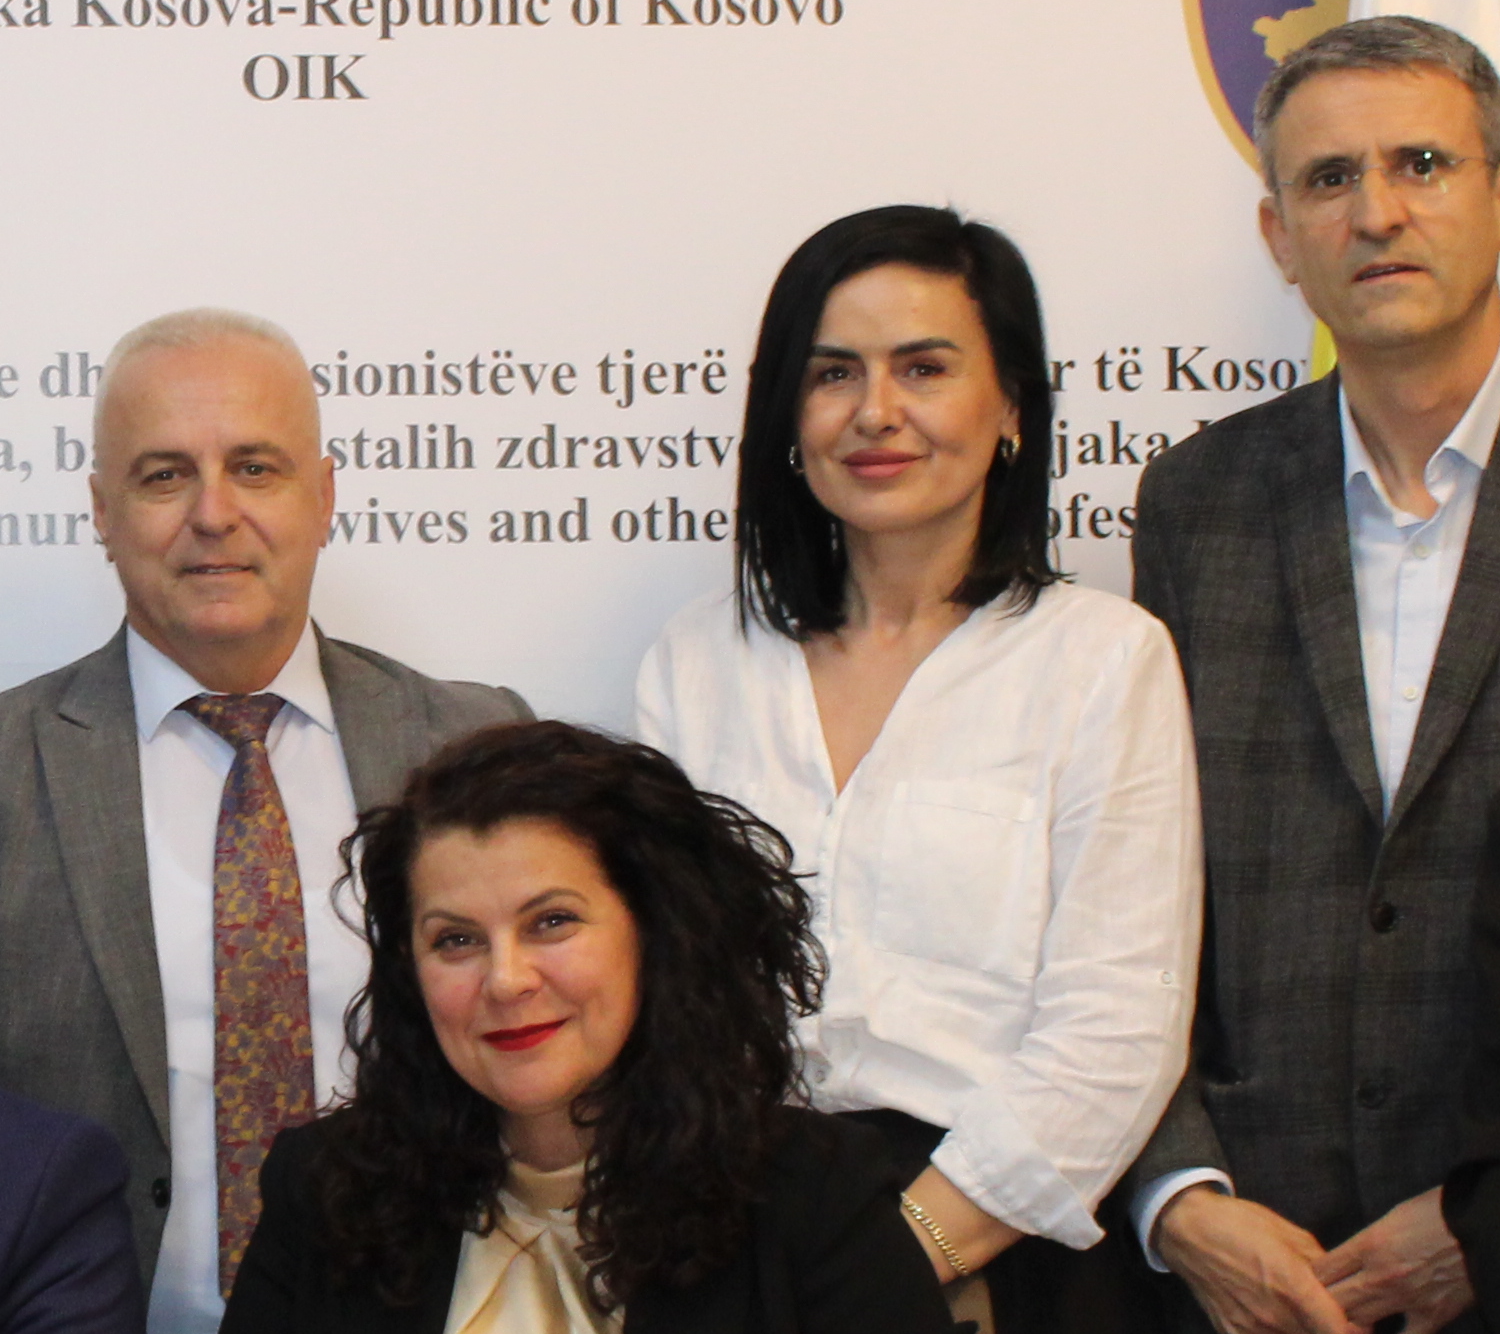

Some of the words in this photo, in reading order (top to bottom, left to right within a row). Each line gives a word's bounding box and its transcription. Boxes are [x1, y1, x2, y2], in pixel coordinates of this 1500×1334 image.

[242, 54, 371, 103] OIK
[38, 351, 105, 398] dh
[310, 349, 578, 398] sionistëve
[595, 348, 728, 410] tjerë
[1093, 346, 1144, 393] të
[1161, 346, 1308, 393] Koso
[326, 423, 477, 471] stalih
[494, 423, 736, 470] zdravstv
[328, 497, 469, 545] wives
[488, 496, 593, 544] and
[611, 495, 740, 544] othe
